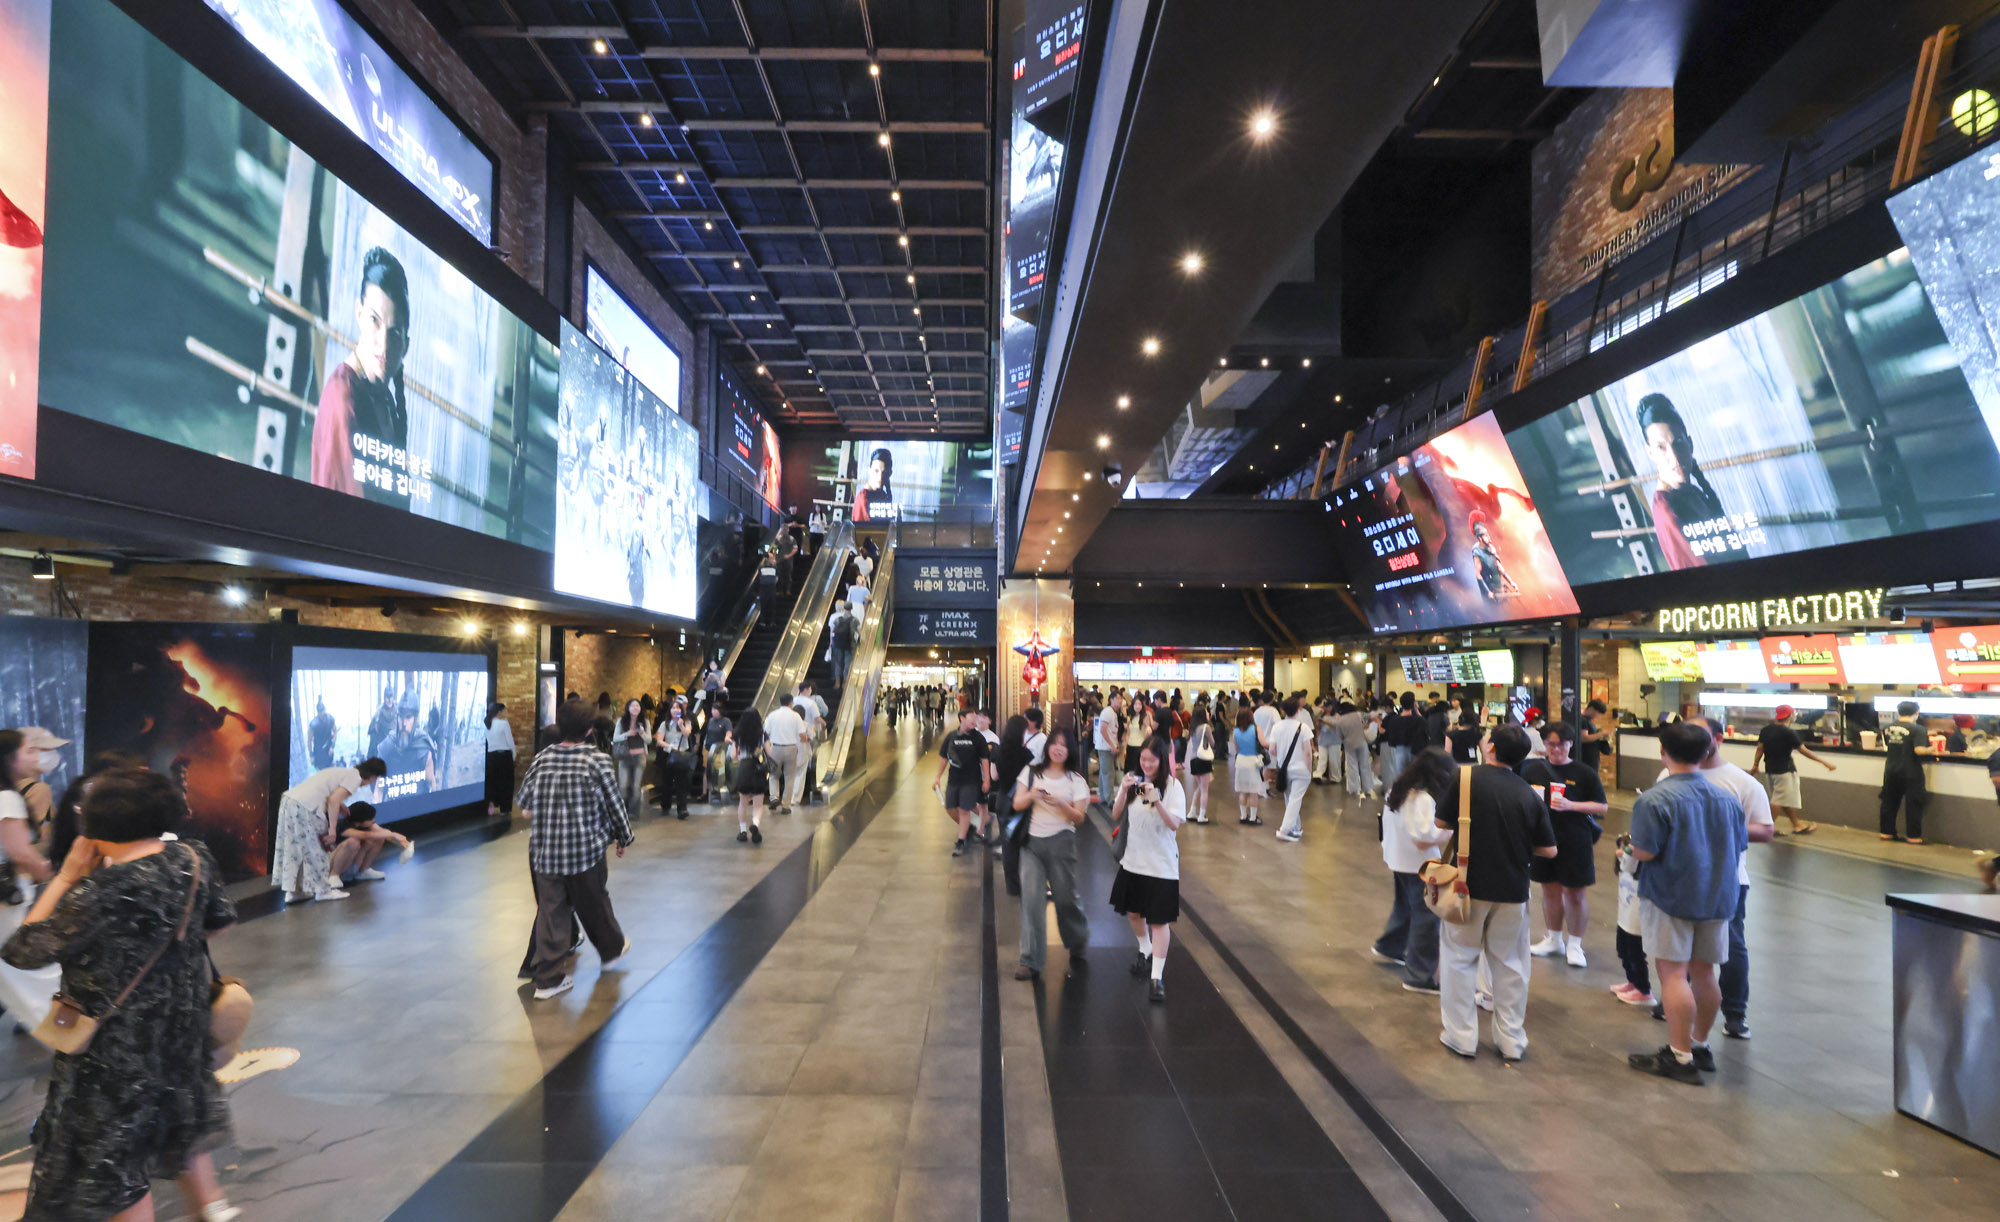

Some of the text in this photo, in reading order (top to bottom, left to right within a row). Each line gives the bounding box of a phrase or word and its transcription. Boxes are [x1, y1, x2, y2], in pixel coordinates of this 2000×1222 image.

[372, 100, 441, 184] ULTRA
[1583, 232, 1634, 273] ANOTHER
[1636, 176, 1705, 235] PARADIGM
[353, 432, 406, 471] 이타카의
[396, 473, 432, 503] 겁니다
[1682, 515, 1731, 540] 이타카의
[1726, 528, 1767, 550] 겁니다
[1372, 526, 1421, 557] 오디세이
[914, 580, 989, 592] 위층에 있습니다.
[920, 566, 983, 579] 모든 상영관은
[1659, 588, 1883, 633] POPCORN FACTORY
[935, 621, 977, 629] SCREENX
[1791, 647, 1836, 664] 키오스크
